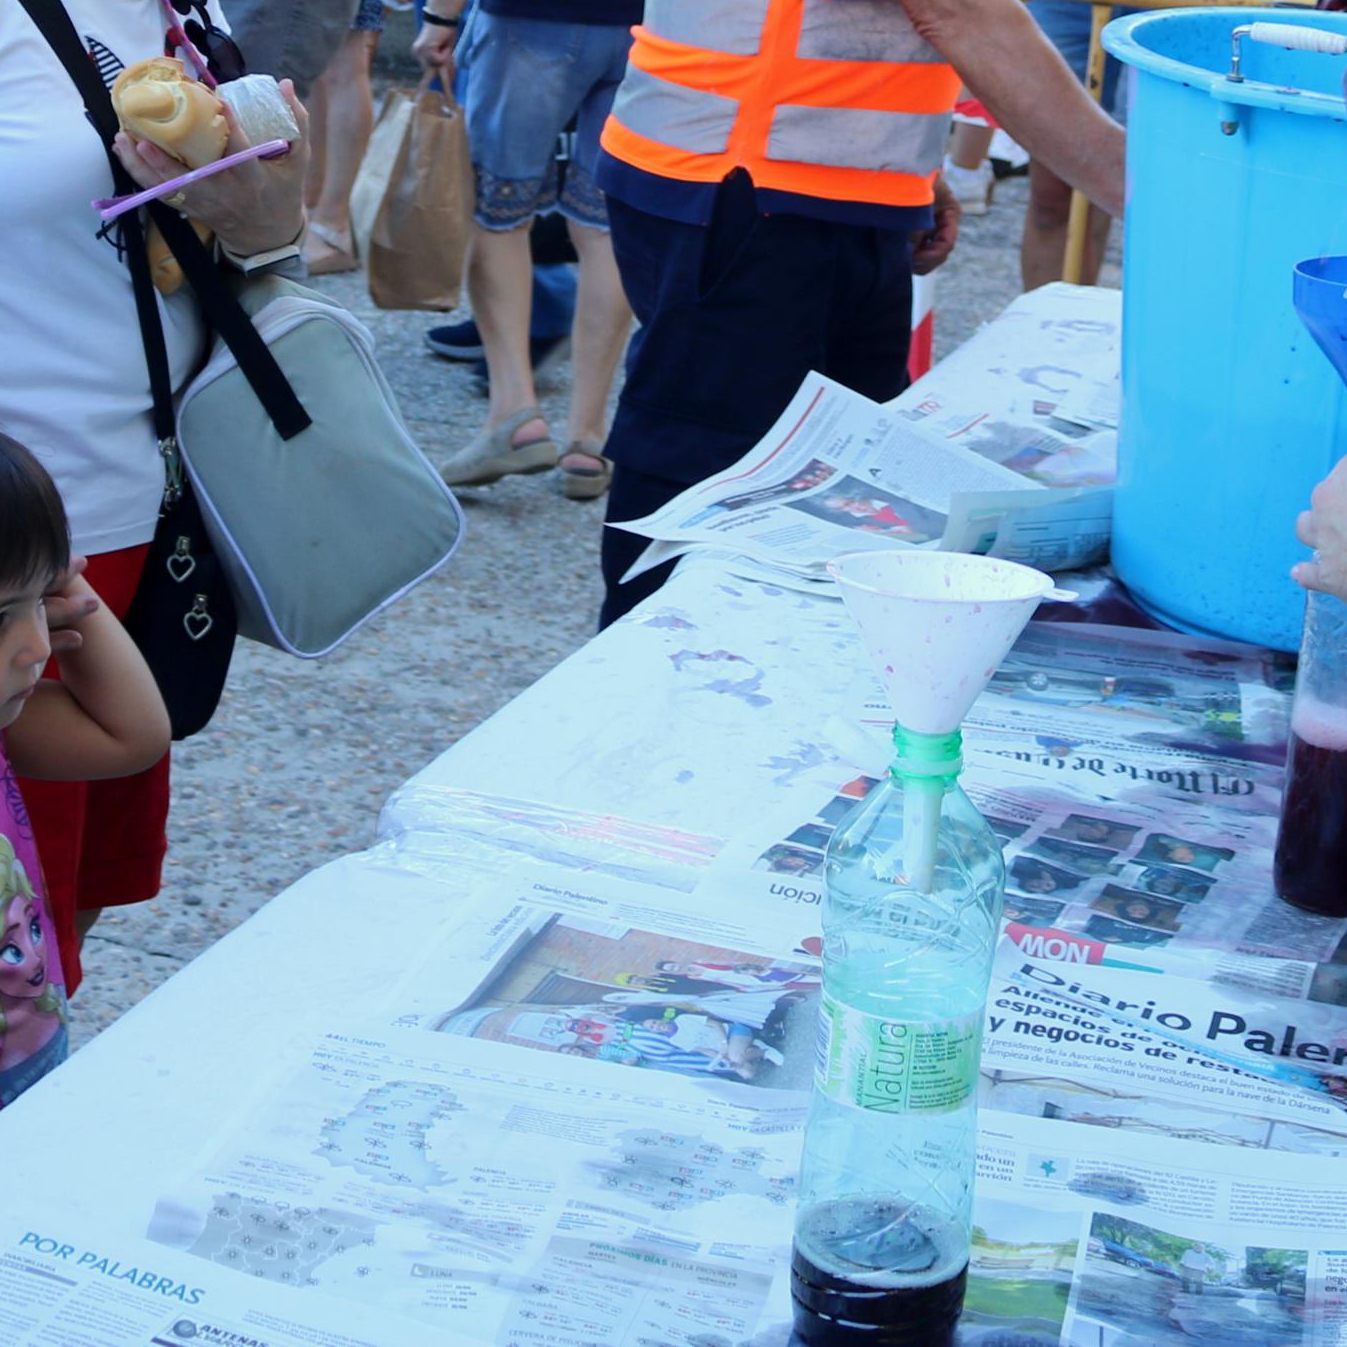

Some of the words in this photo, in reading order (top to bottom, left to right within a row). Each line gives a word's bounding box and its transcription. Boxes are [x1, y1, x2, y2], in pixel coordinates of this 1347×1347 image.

[1113, 762, 1205, 793] Norte
[995, 998, 1111, 1034] espacios
[1020, 963, 1192, 1031] Diario
[989, 1016, 1006, 1032] y
[1013, 1020, 1135, 1052] negocios
[1144, 1045, 1178, 1061] de
[864, 1021, 907, 1114] Natura
[18, 1231, 76, 1261] POR
[76, 1251, 207, 1305] PALABRAS
[199, 1323, 270, 1347] ANTENAS
